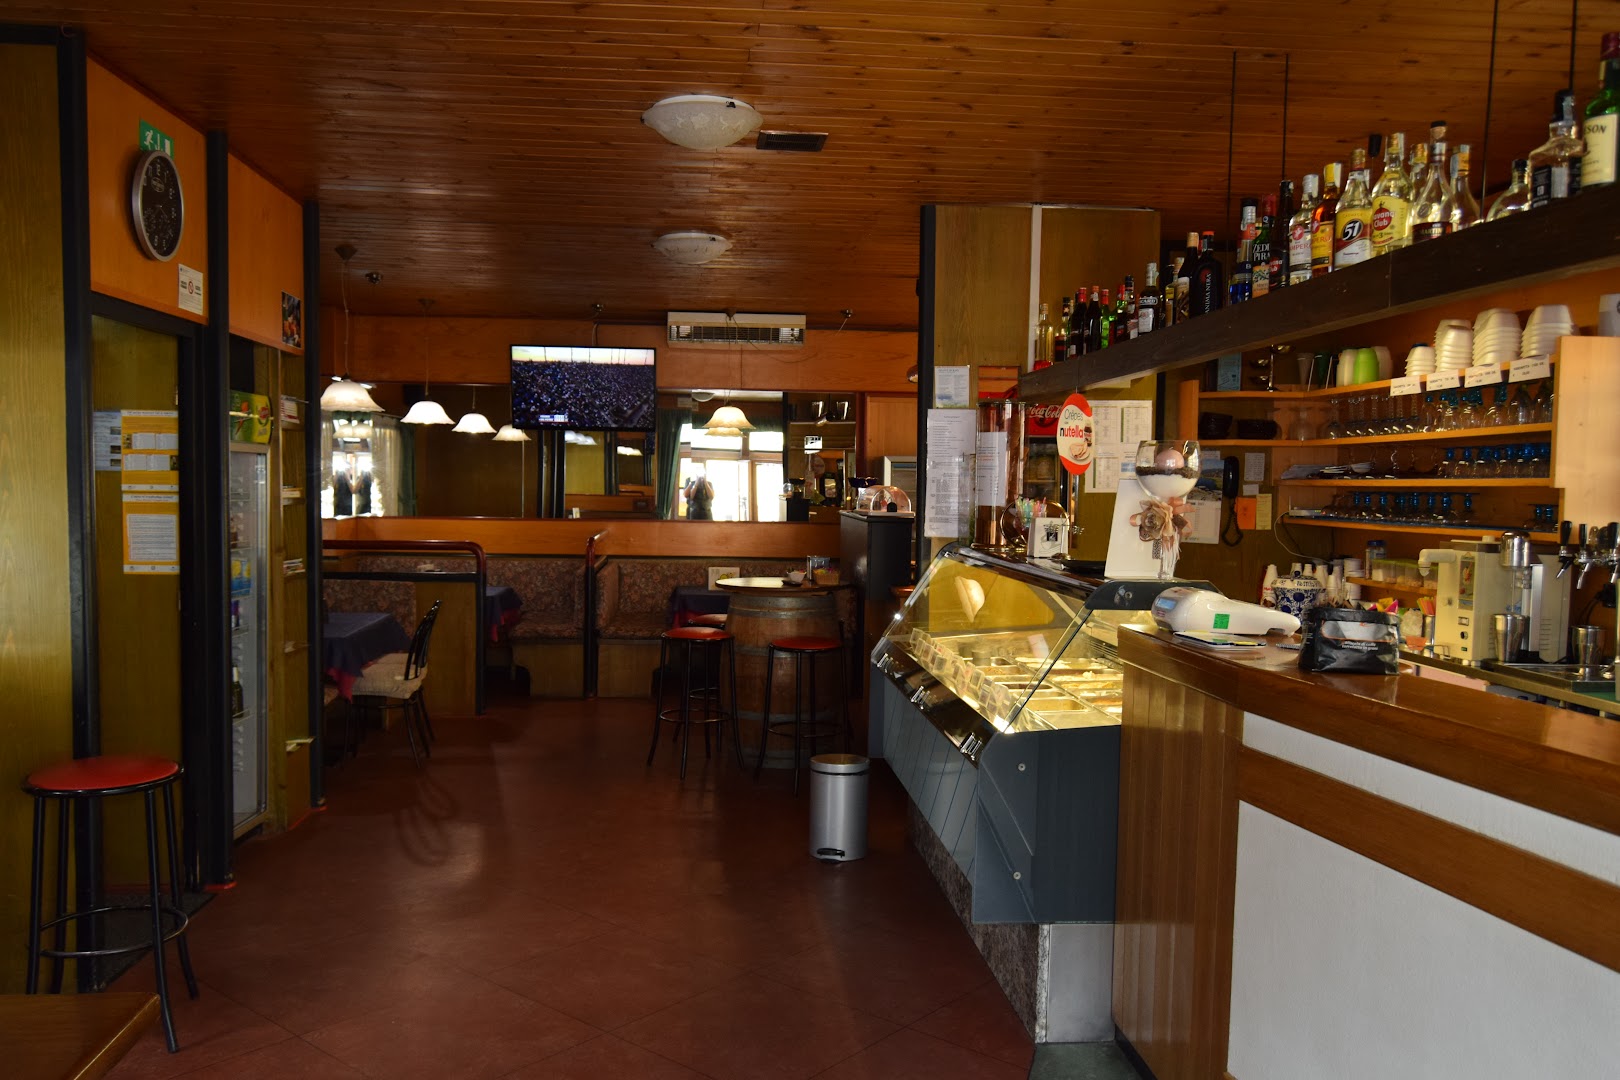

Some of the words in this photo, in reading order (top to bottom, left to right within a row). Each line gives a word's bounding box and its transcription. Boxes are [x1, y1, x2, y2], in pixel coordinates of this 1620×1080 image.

[1374, 211, 1395, 220] avana
[1342, 221, 1360, 241] 51
[1064, 408, 1084, 422] Crêpes
[1059, 425, 1084, 438] nutella
